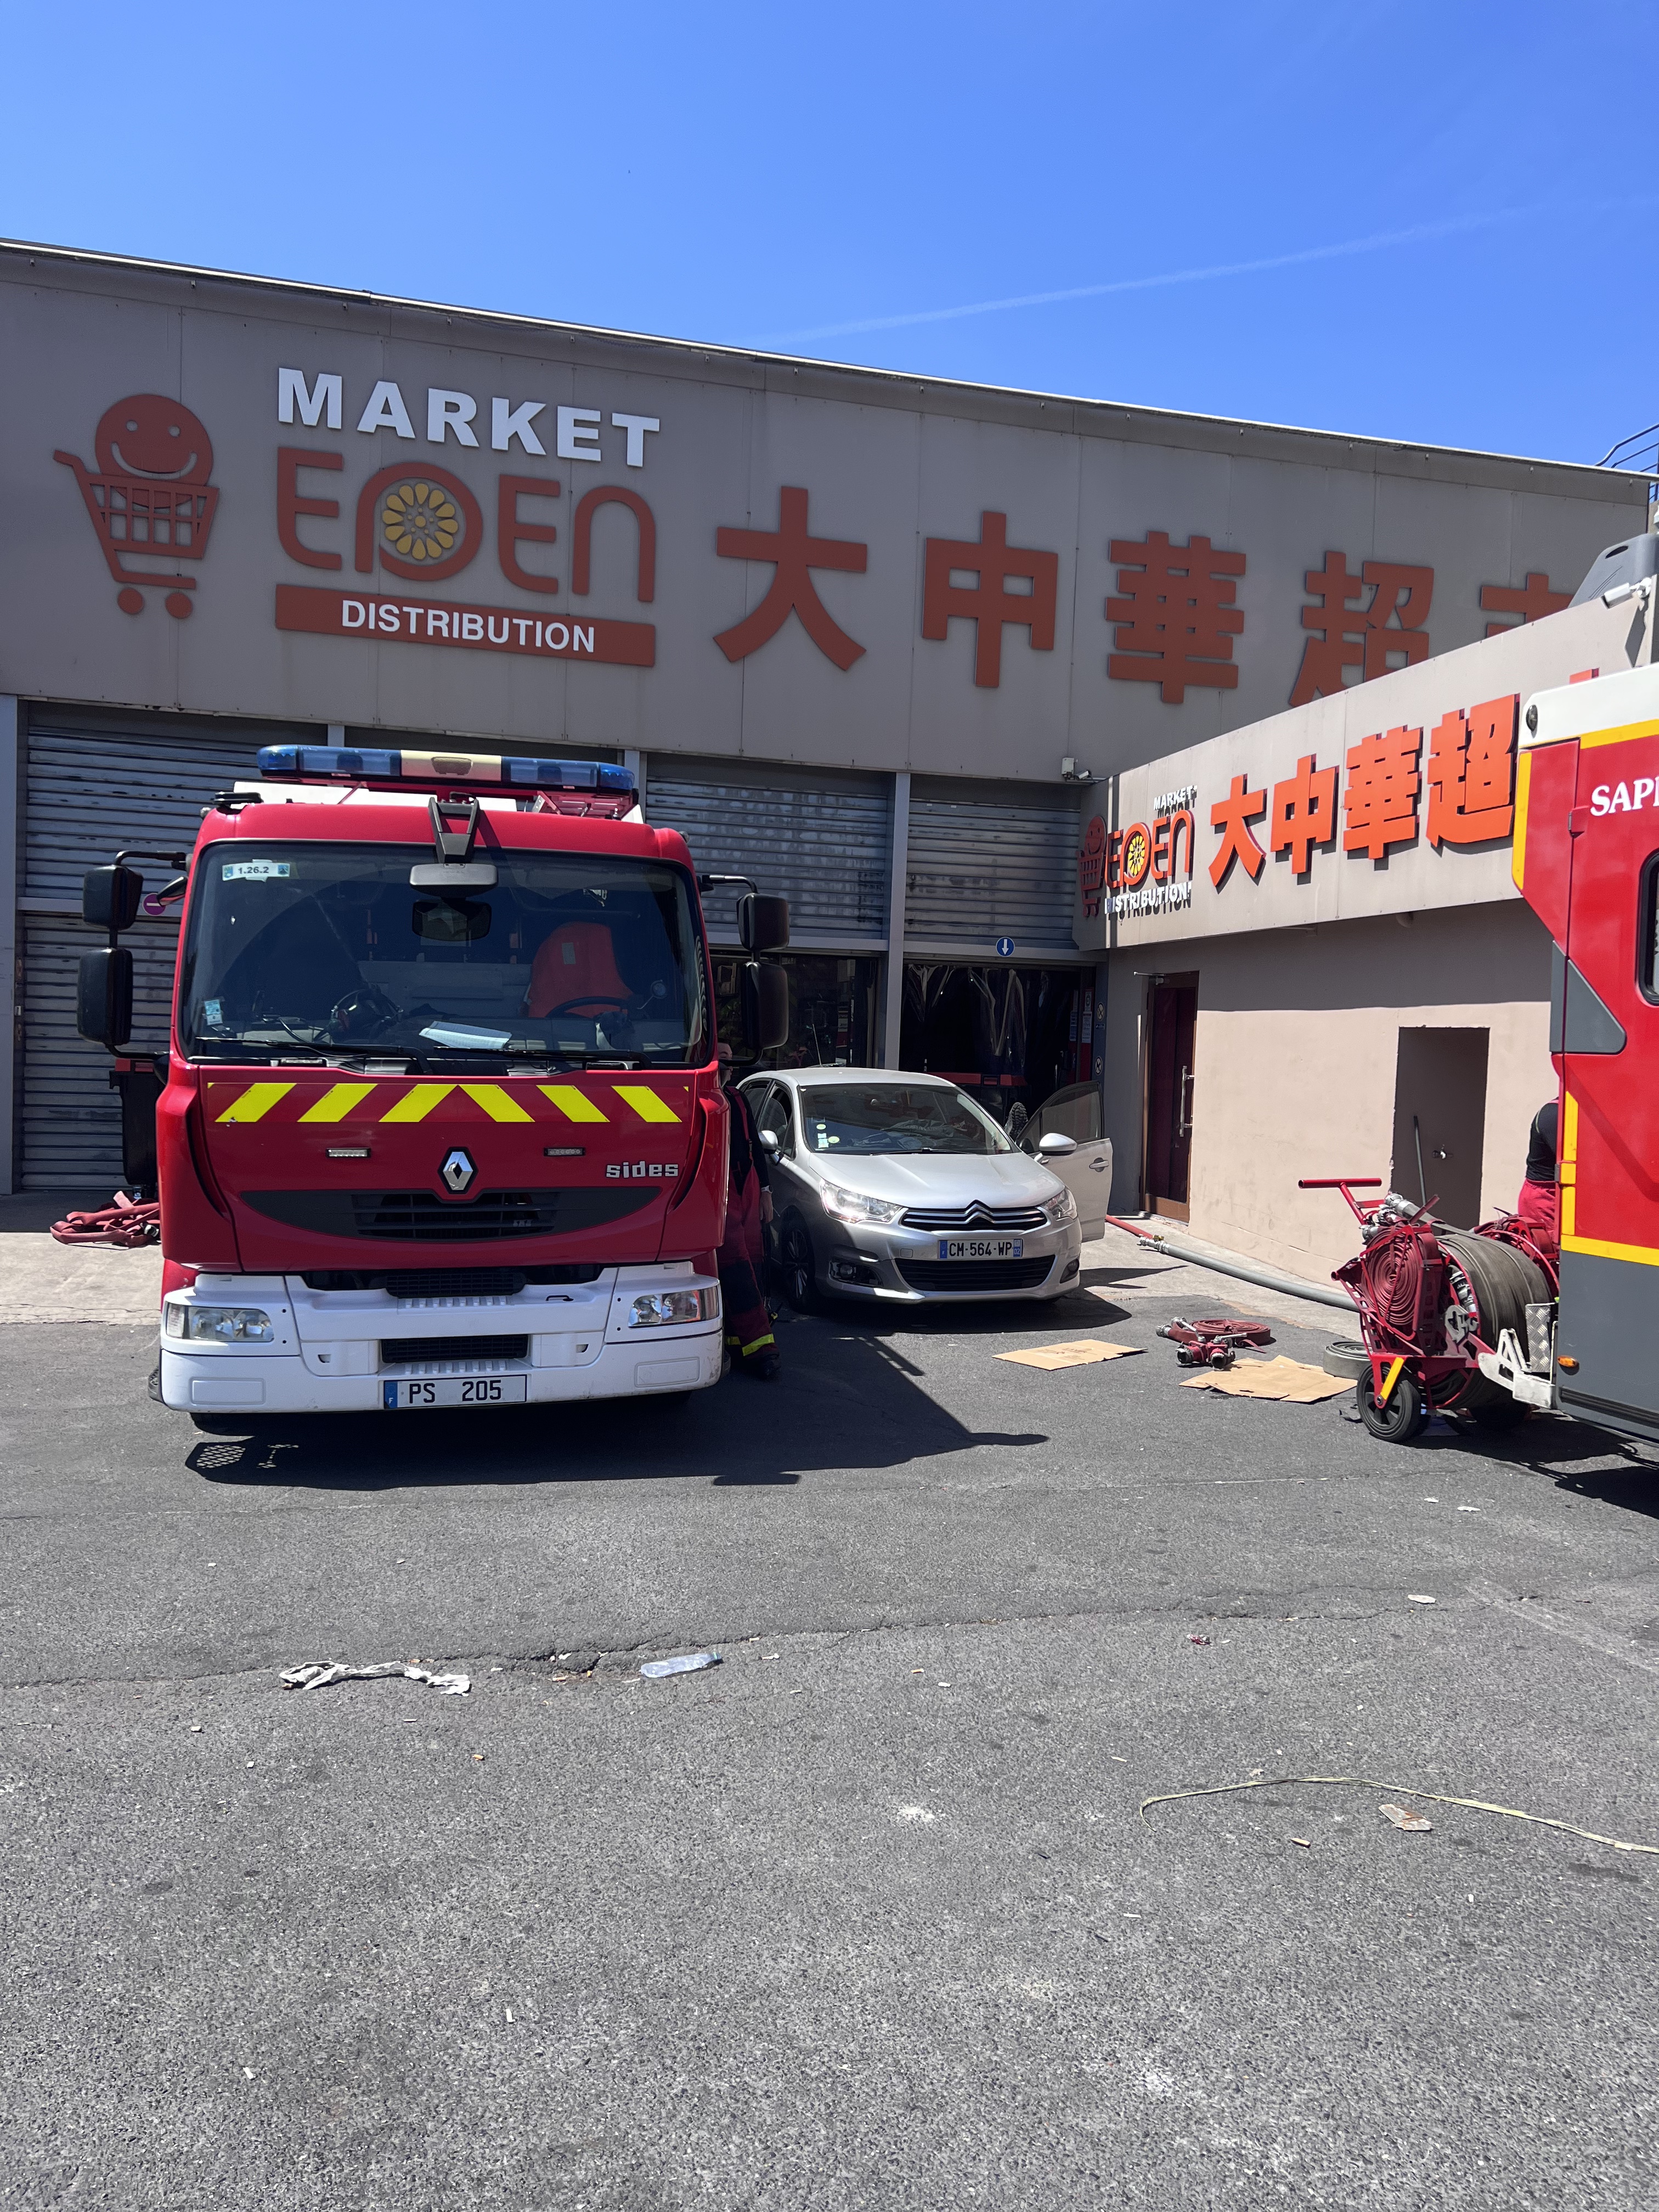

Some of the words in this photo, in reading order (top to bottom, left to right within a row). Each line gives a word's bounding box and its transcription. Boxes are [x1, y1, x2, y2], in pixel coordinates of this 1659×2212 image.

[278, 368, 660, 467] MARKET
[341, 600, 595, 652] DISTRIBUTION
[1208, 668, 1599, 887] 大中華超
[1154, 785, 1194, 810] MARKET
[238, 866, 269, 874] 1.26.2
[606, 1161, 679, 1178] sides
[949, 1242, 1012, 1257] CM-564-WP
[410, 1383, 436, 1404] PS
[462, 1380, 501, 1402] 205
